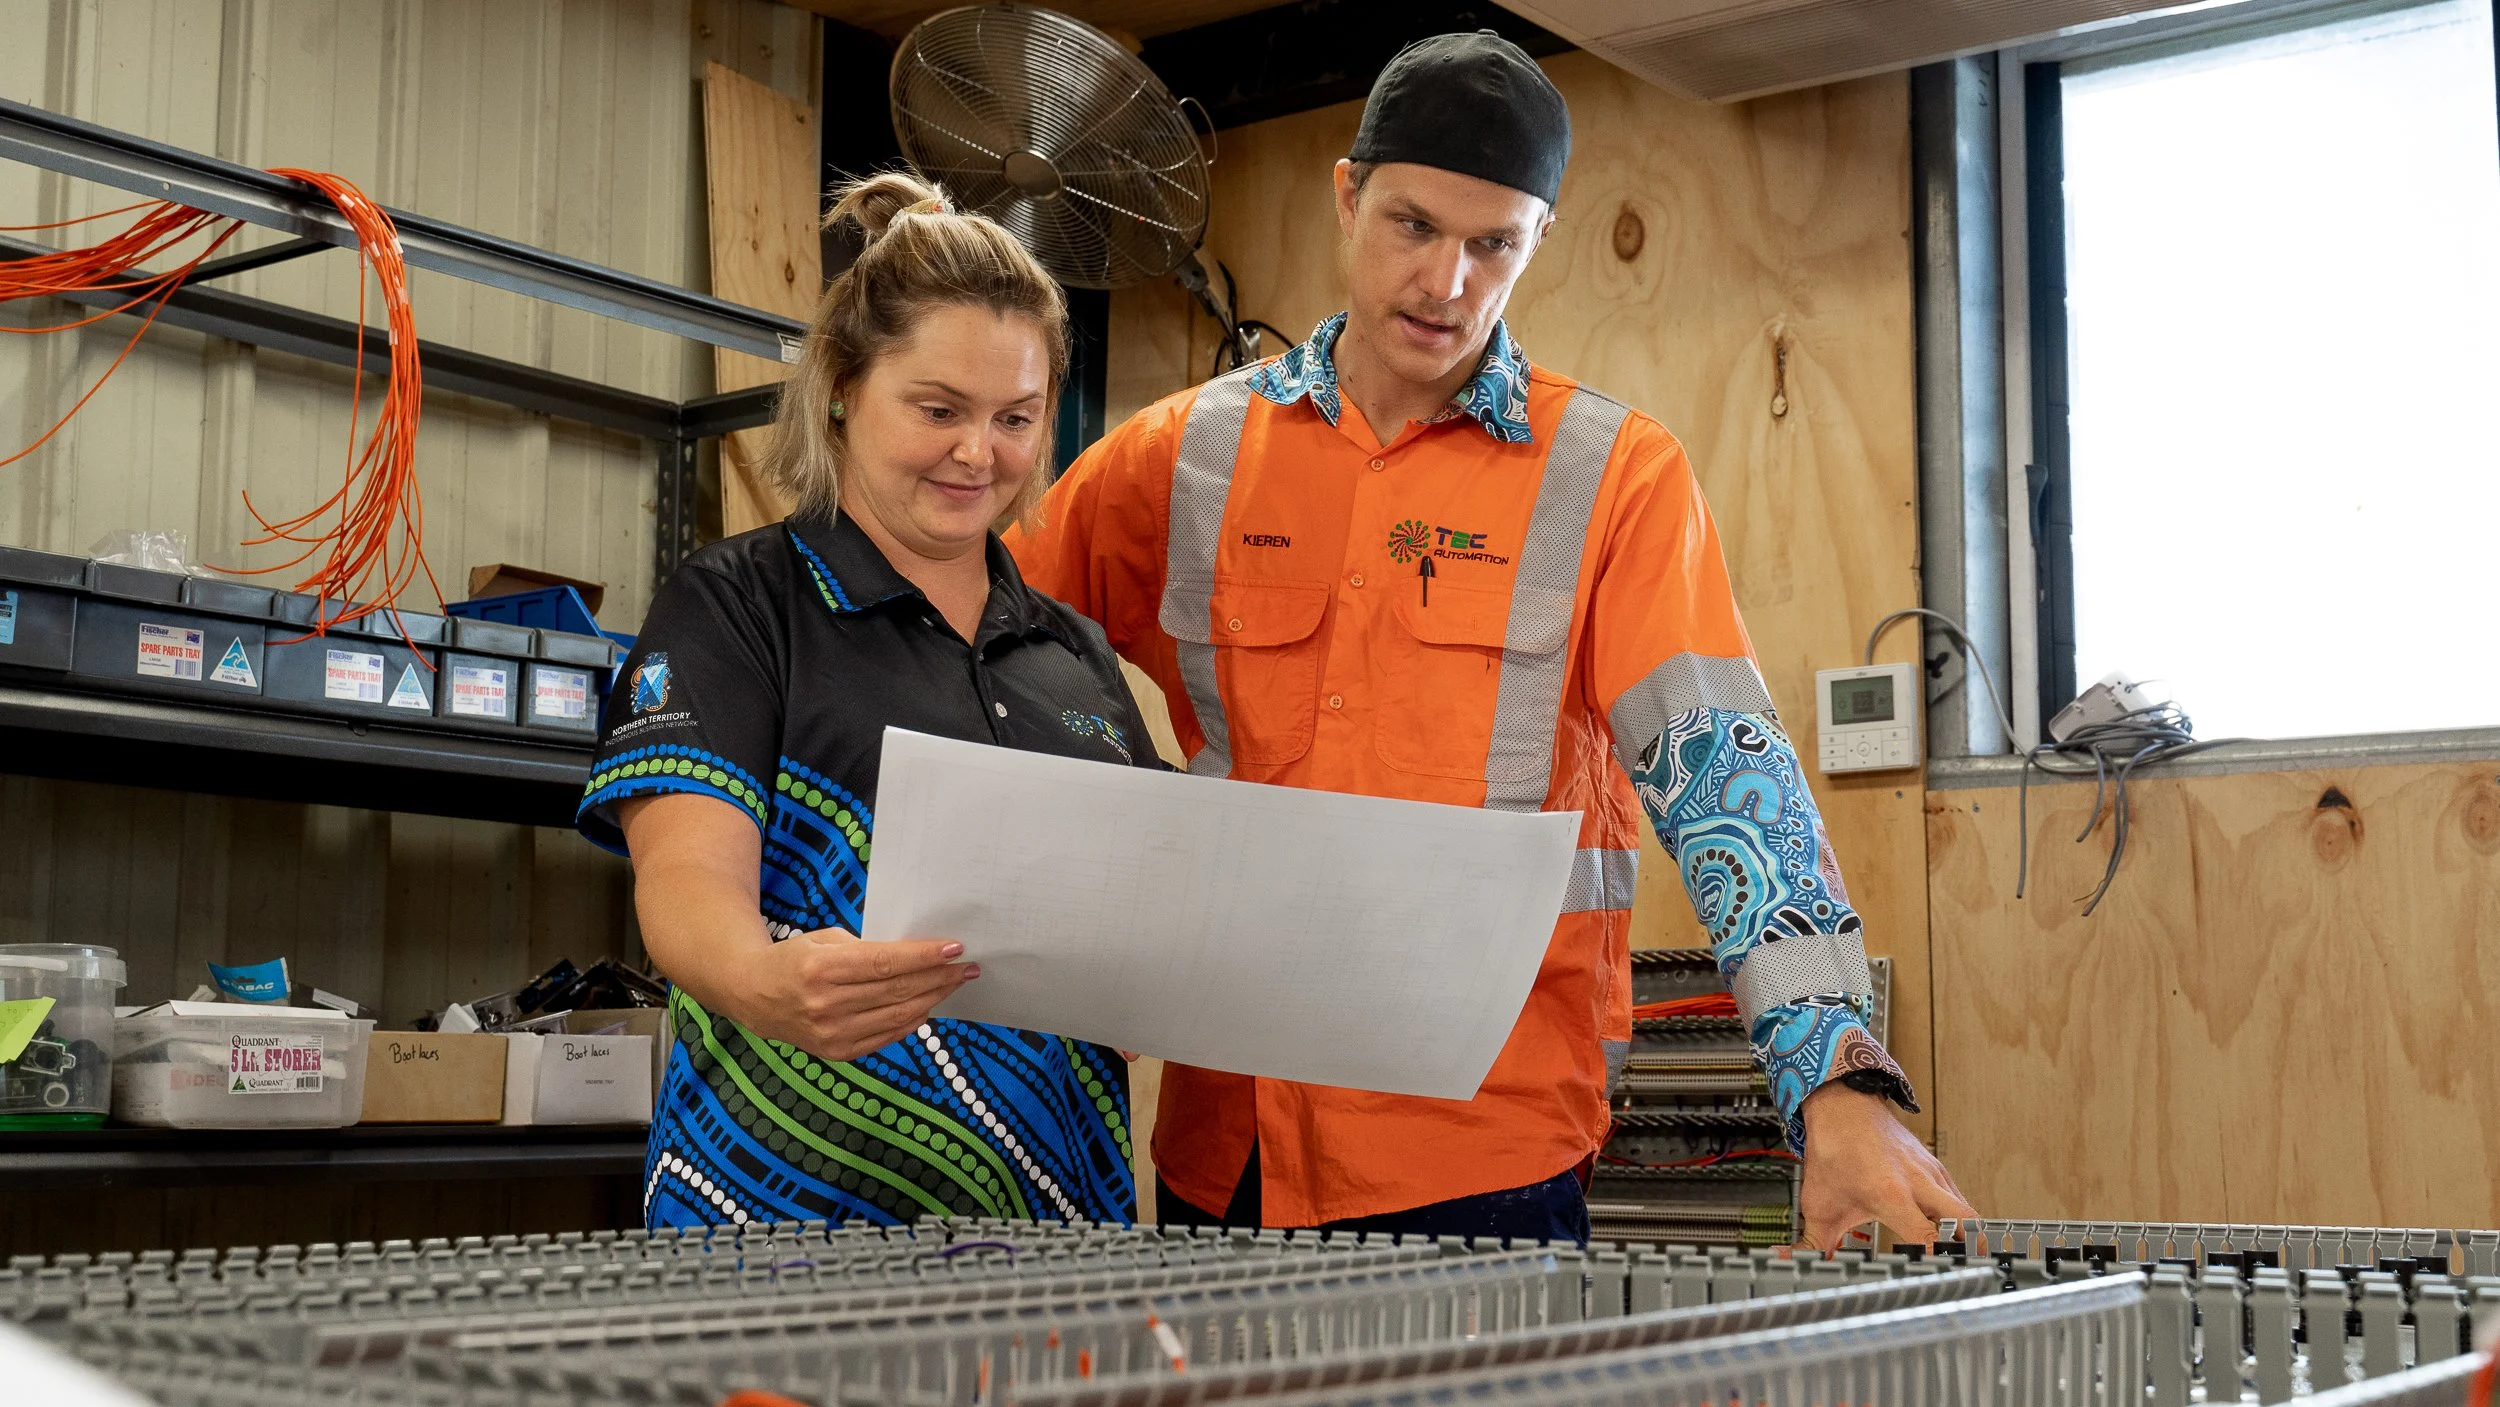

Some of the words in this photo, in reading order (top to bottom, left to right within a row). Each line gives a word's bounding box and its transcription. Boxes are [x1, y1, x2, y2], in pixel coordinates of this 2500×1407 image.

[1243, 533, 1291, 548] KIEREN
[1435, 526, 1488, 550] TEC
[1434, 549, 1510, 565] AUTOMATION
[140, 642, 161, 655] SPARE
[162, 645, 184, 658] PARTS
[185, 648, 201, 660] TRAY
[328, 667, 347, 680] SPARE
[348, 669, 367, 682] PARTS
[368, 672, 383, 683] TRAY
[455, 683, 472, 695] SPARE
[472, 685, 490, 696] PARTS
[491, 687, 505, 697] TRAY
[537, 686, 553, 697] SPARE
[555, 688, 572, 699] PARTS
[572, 689, 585, 701] TRAY
[612, 717, 648, 737] NORTHERN
[649, 711, 691, 723] TERRITORY
[665, 720, 699, 729] NETWORK
[231, 1034, 280, 1049] QUADRANT
[388, 1042, 416, 1064] Boot
[562, 1042, 588, 1061] Boot
[591, 1043, 610, 1057] laces
[230, 1048, 239, 1073] 5
[264, 1048, 322, 1072] STORER
